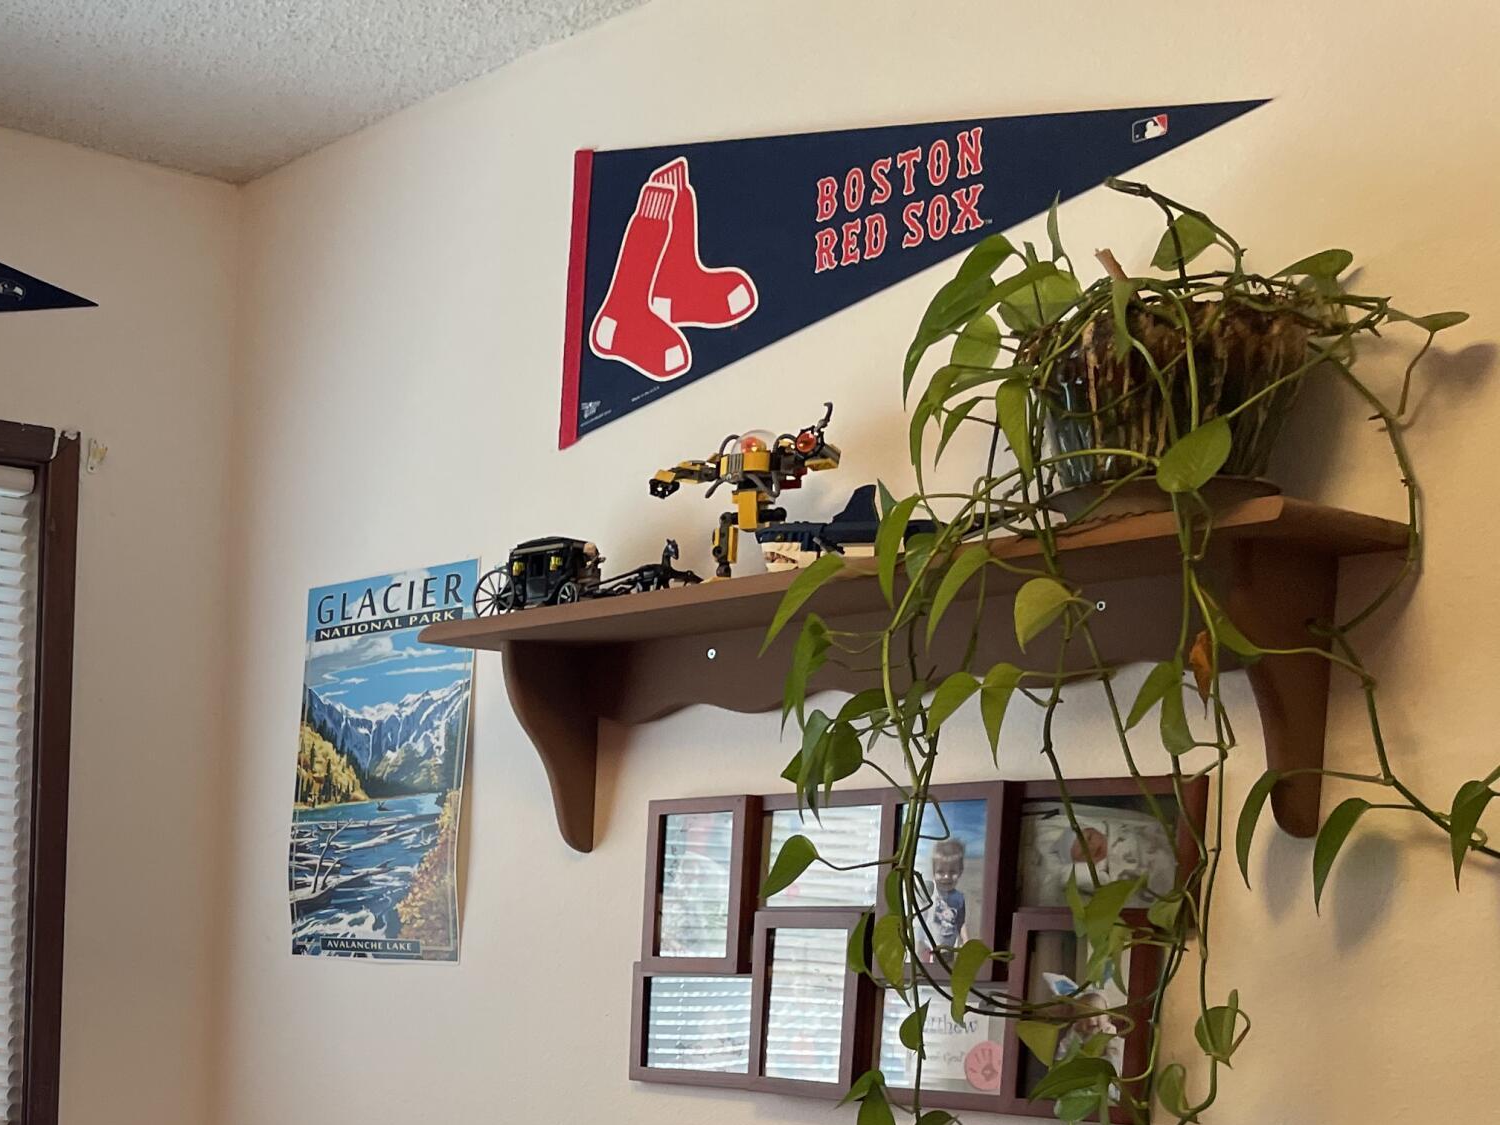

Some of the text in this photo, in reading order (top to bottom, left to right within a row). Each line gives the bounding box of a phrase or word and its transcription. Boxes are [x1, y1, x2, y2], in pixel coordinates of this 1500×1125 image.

[816, 126, 983, 223] BOSTON
[814, 183, 985, 274] RED SOX
[317, 573, 464, 625] GLACIER
[320, 610, 455, 640] NATIONAL PARK
[327, 940, 412, 951] AVALANCHE LAKE
